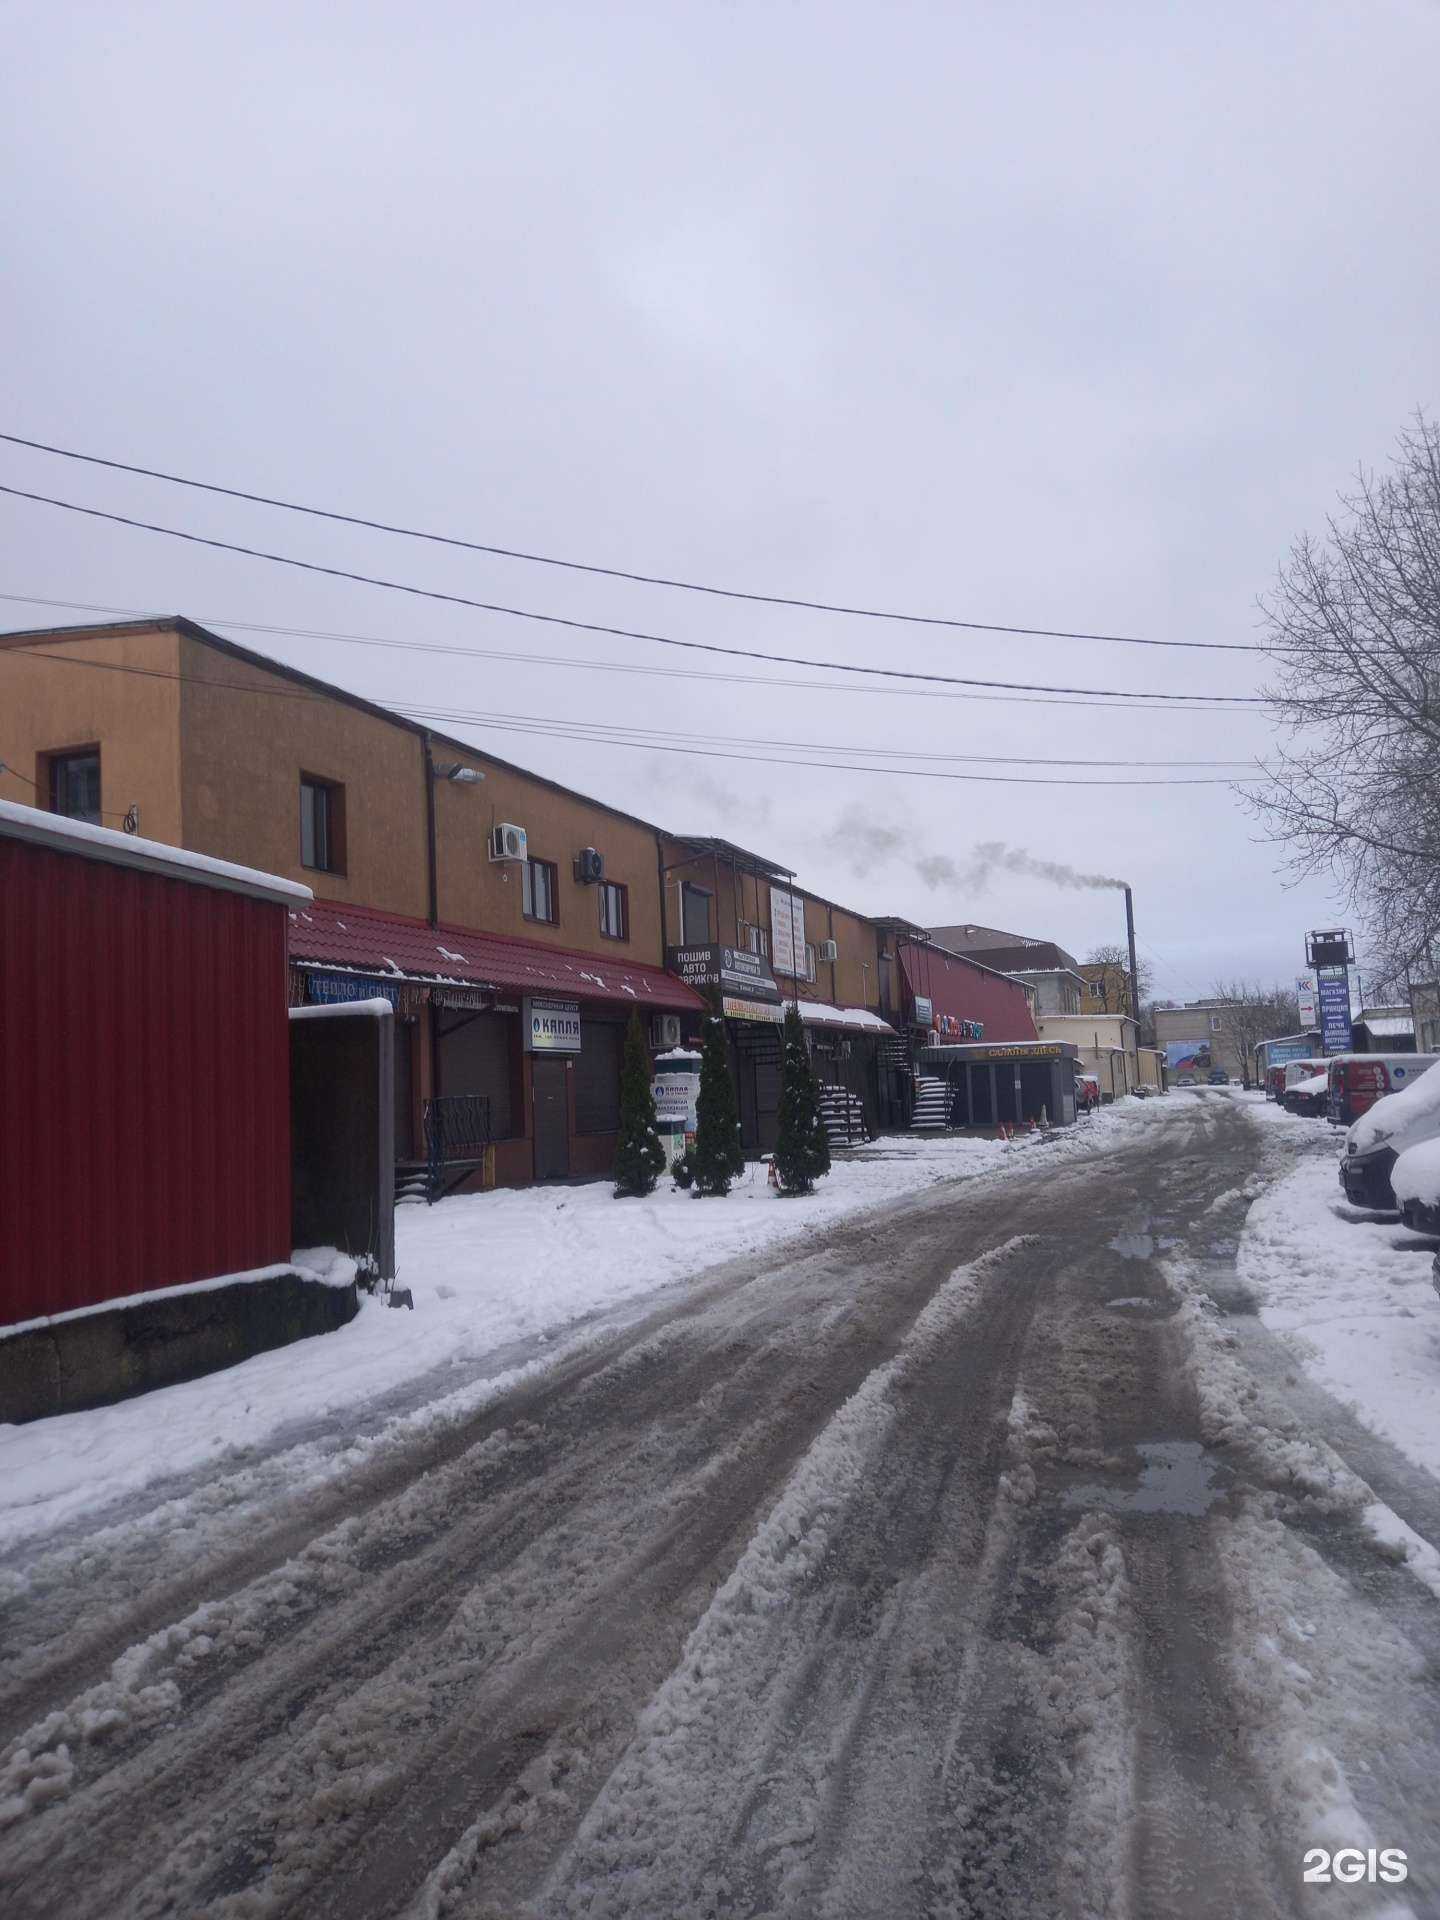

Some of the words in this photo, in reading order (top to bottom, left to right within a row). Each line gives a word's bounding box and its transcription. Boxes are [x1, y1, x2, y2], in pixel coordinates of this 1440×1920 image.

[677, 951, 711, 963] ПОШИВ
[682, 962, 707, 974] АВТО
[679, 973, 719, 985] ВРИКОВ
[543, 1018, 580, 1035] КАПЛЯ
